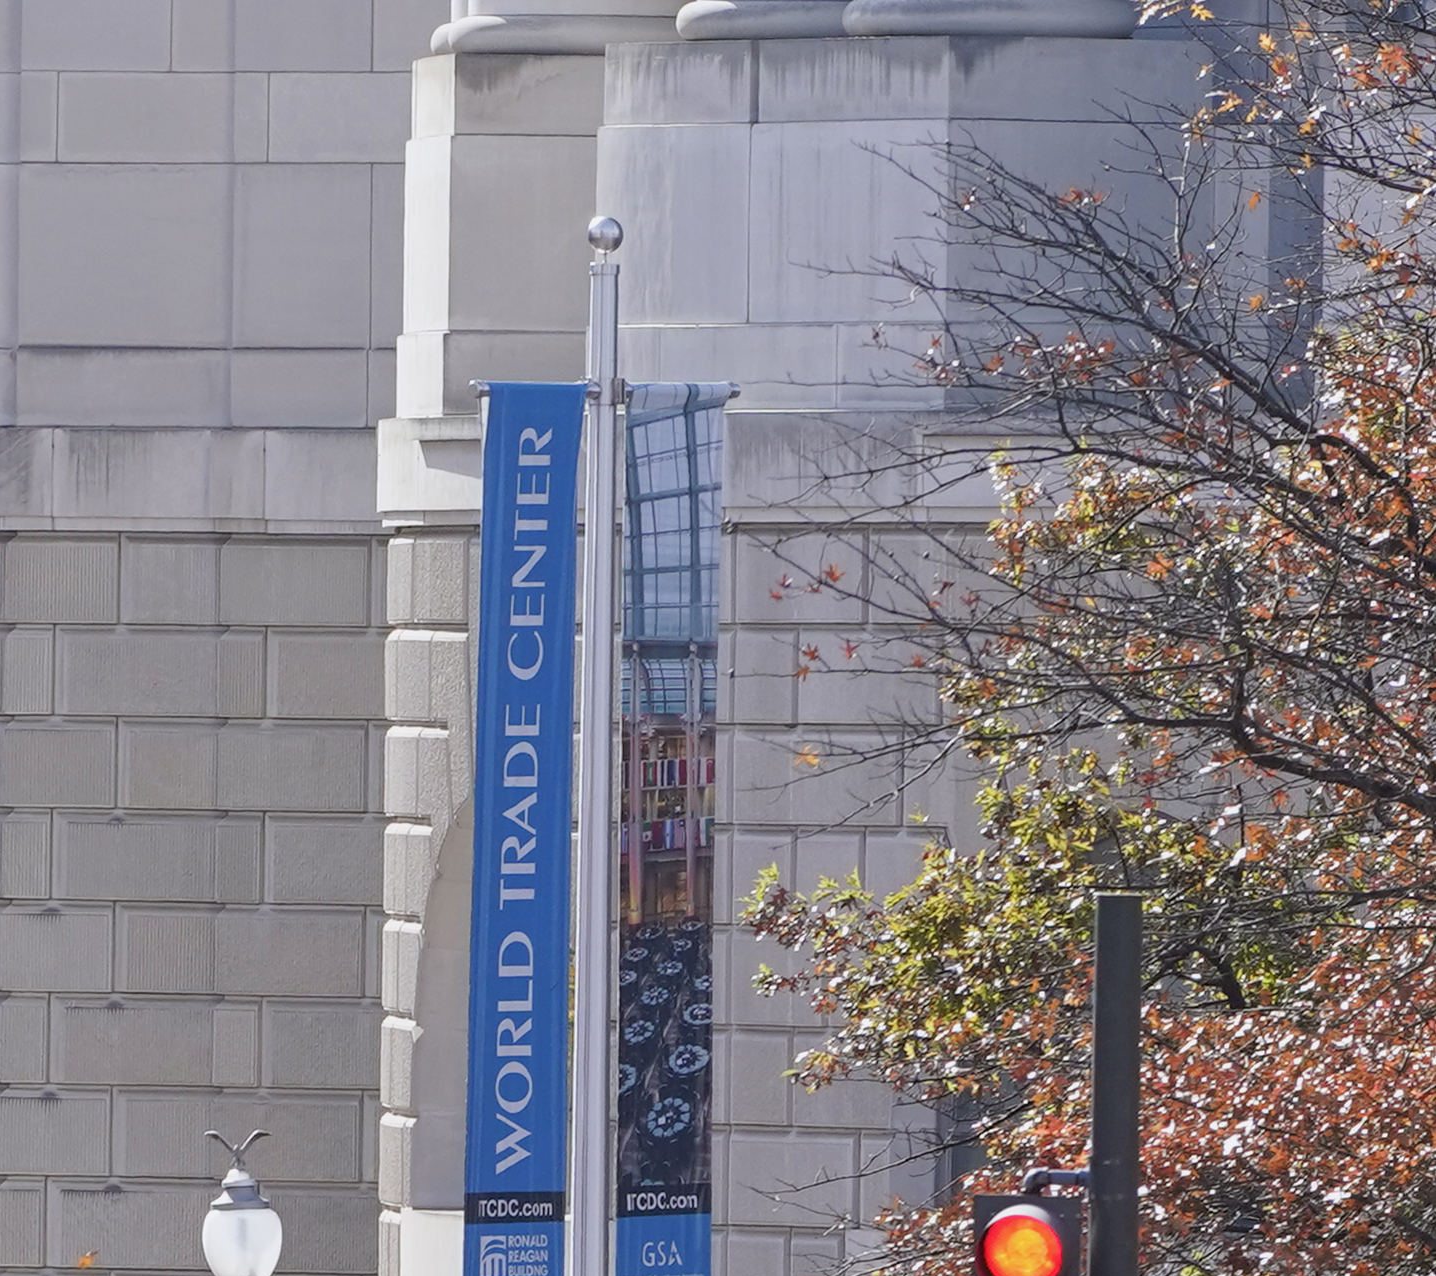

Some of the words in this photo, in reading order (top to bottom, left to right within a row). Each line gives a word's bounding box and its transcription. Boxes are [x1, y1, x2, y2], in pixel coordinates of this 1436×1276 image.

[506, 427, 554, 681] CENTER
[499, 703, 542, 910] TRADE
[494, 930, 535, 1177] WORLD
[478, 1199, 553, 1218] ITCDC.com
[507, 1234, 548, 1247] RONALD
[507, 1250, 548, 1263] REAGAN
[642, 1240, 683, 1267] GSA
[507, 1264, 548, 1276] BUILDNG
